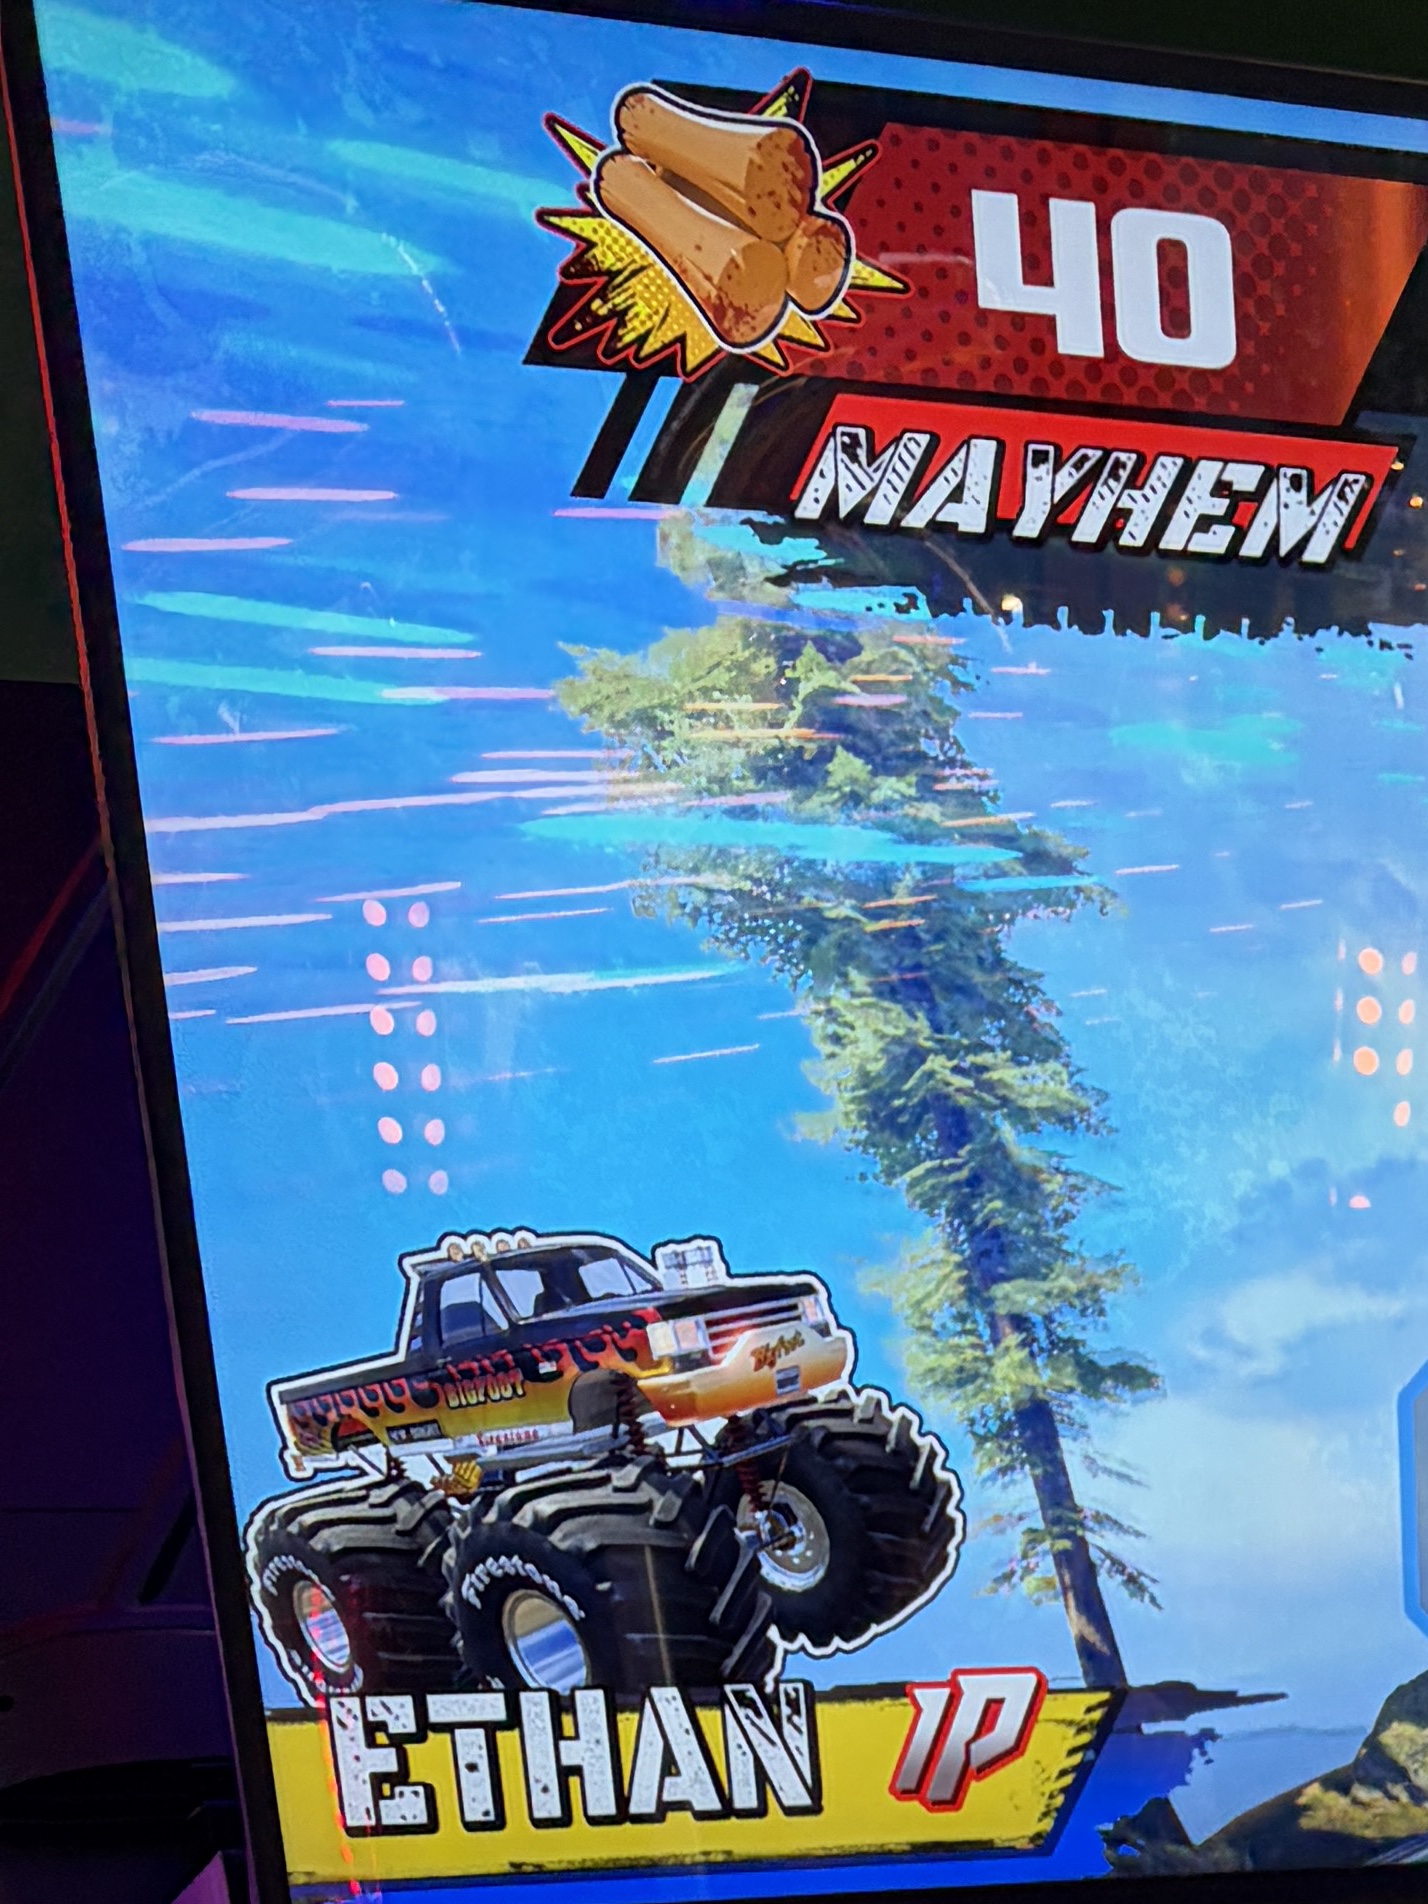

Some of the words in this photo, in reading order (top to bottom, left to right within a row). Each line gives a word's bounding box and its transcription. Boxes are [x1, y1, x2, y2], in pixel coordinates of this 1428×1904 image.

[969, 187, 1238, 371] 40
[794, 424, 1368, 564] MAYHEM
[328, 1682, 824, 1832] ETHAN
[890, 1666, 1047, 1811] 1P
